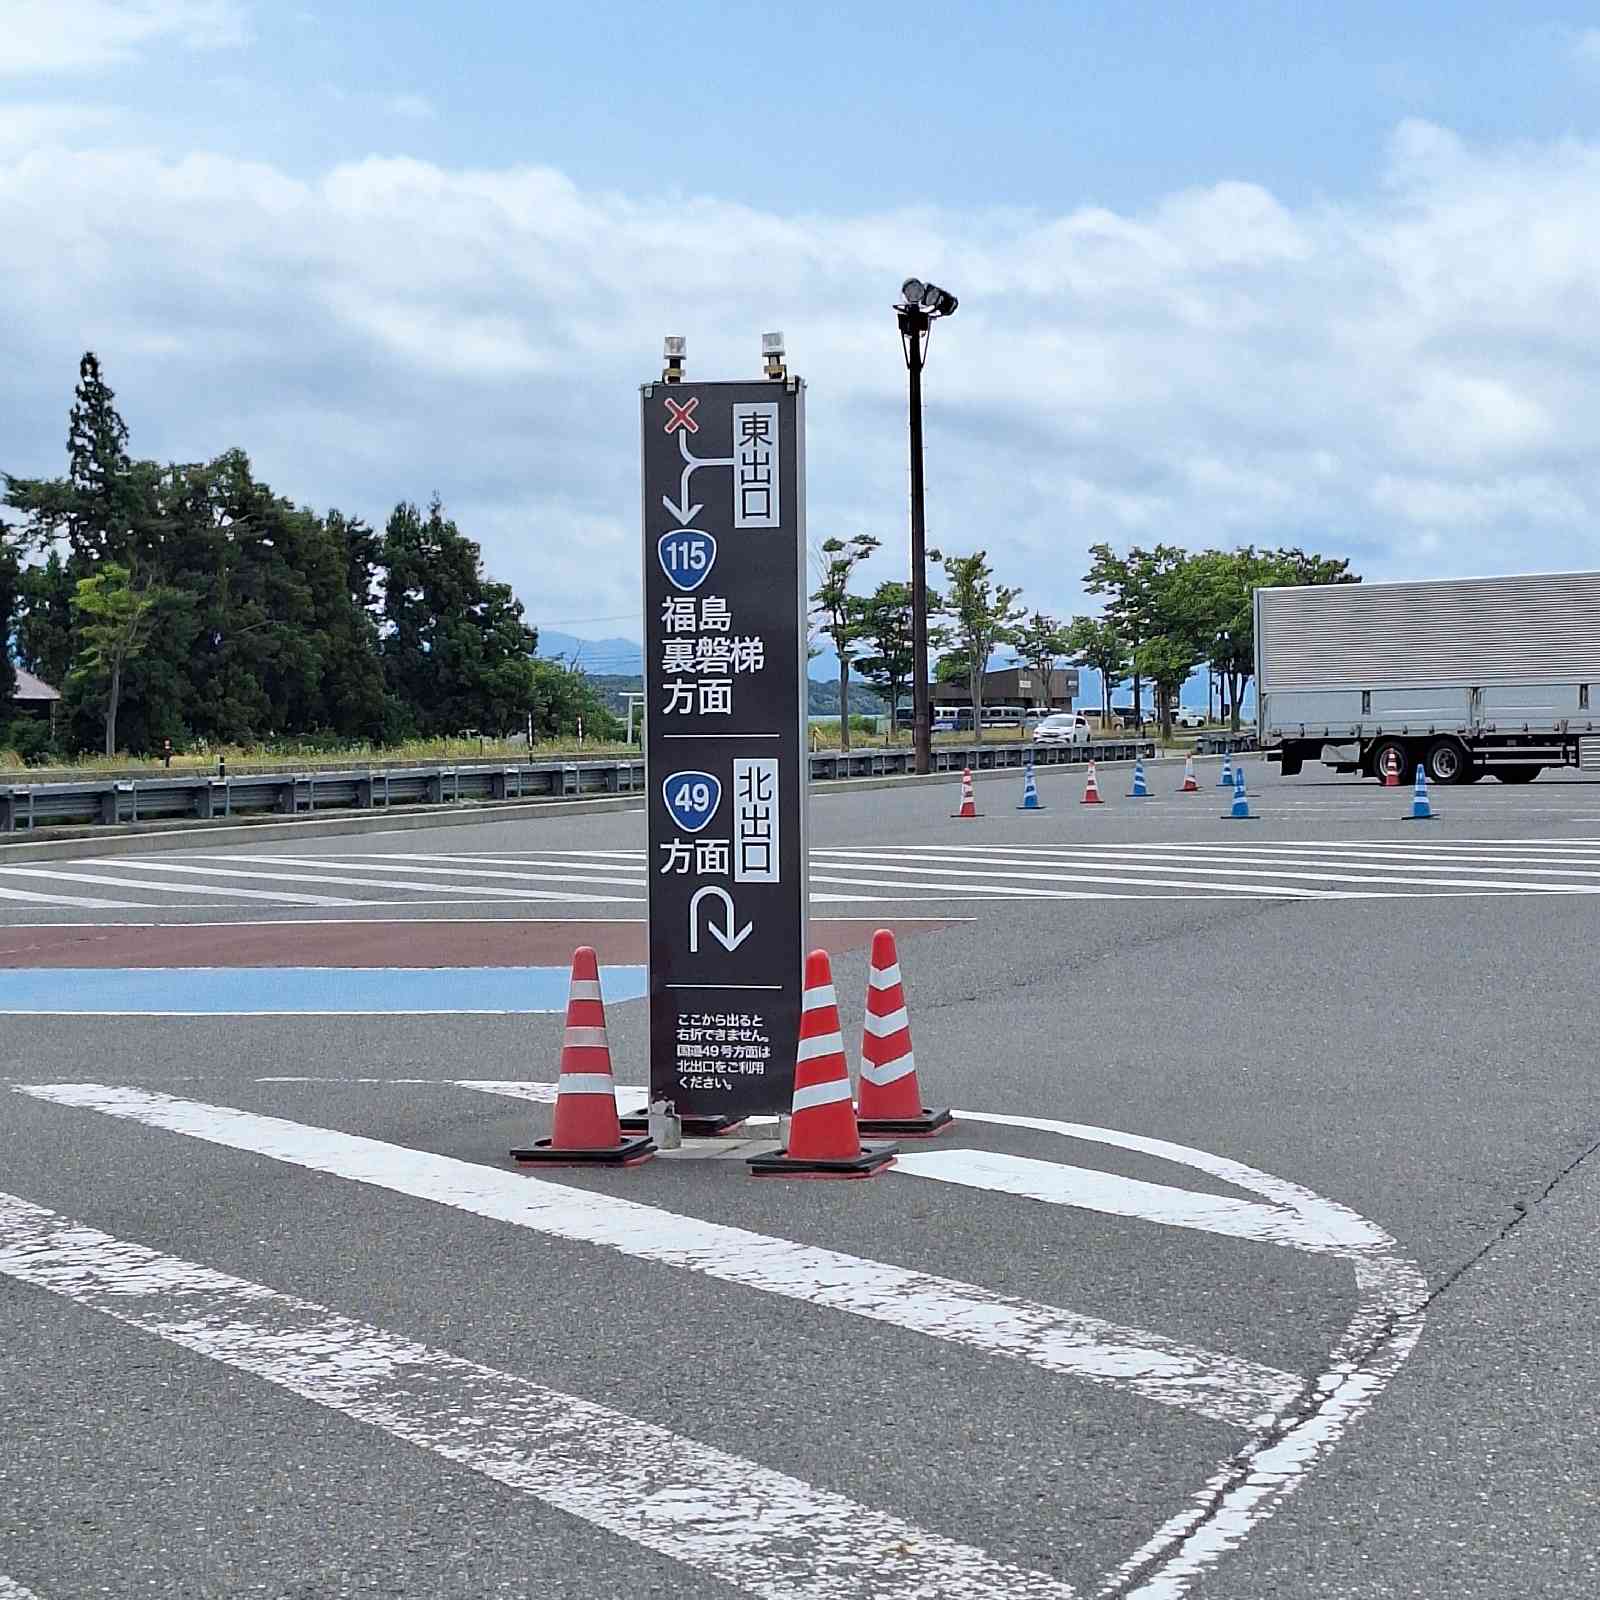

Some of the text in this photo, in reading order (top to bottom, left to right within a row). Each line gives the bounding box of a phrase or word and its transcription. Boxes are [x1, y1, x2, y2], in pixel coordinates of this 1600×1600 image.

[738, 412, 773, 520] 東出口
[666, 541, 706, 570] 115
[661, 596, 732, 633] 福島
[661, 636, 764, 674] 裏磐梯
[661, 679, 733, 716] 方面
[674, 783, 710, 812] 49
[738, 766, 773, 874] 北出口
[660, 839, 729, 875] 方面
[676, 1028, 769, 1042] 右折できません。
[678, 1014, 763, 1027] ここから出ると
[676, 1060, 765, 1075] 北出口をご利用
[679, 1075, 732, 1090] ください。
